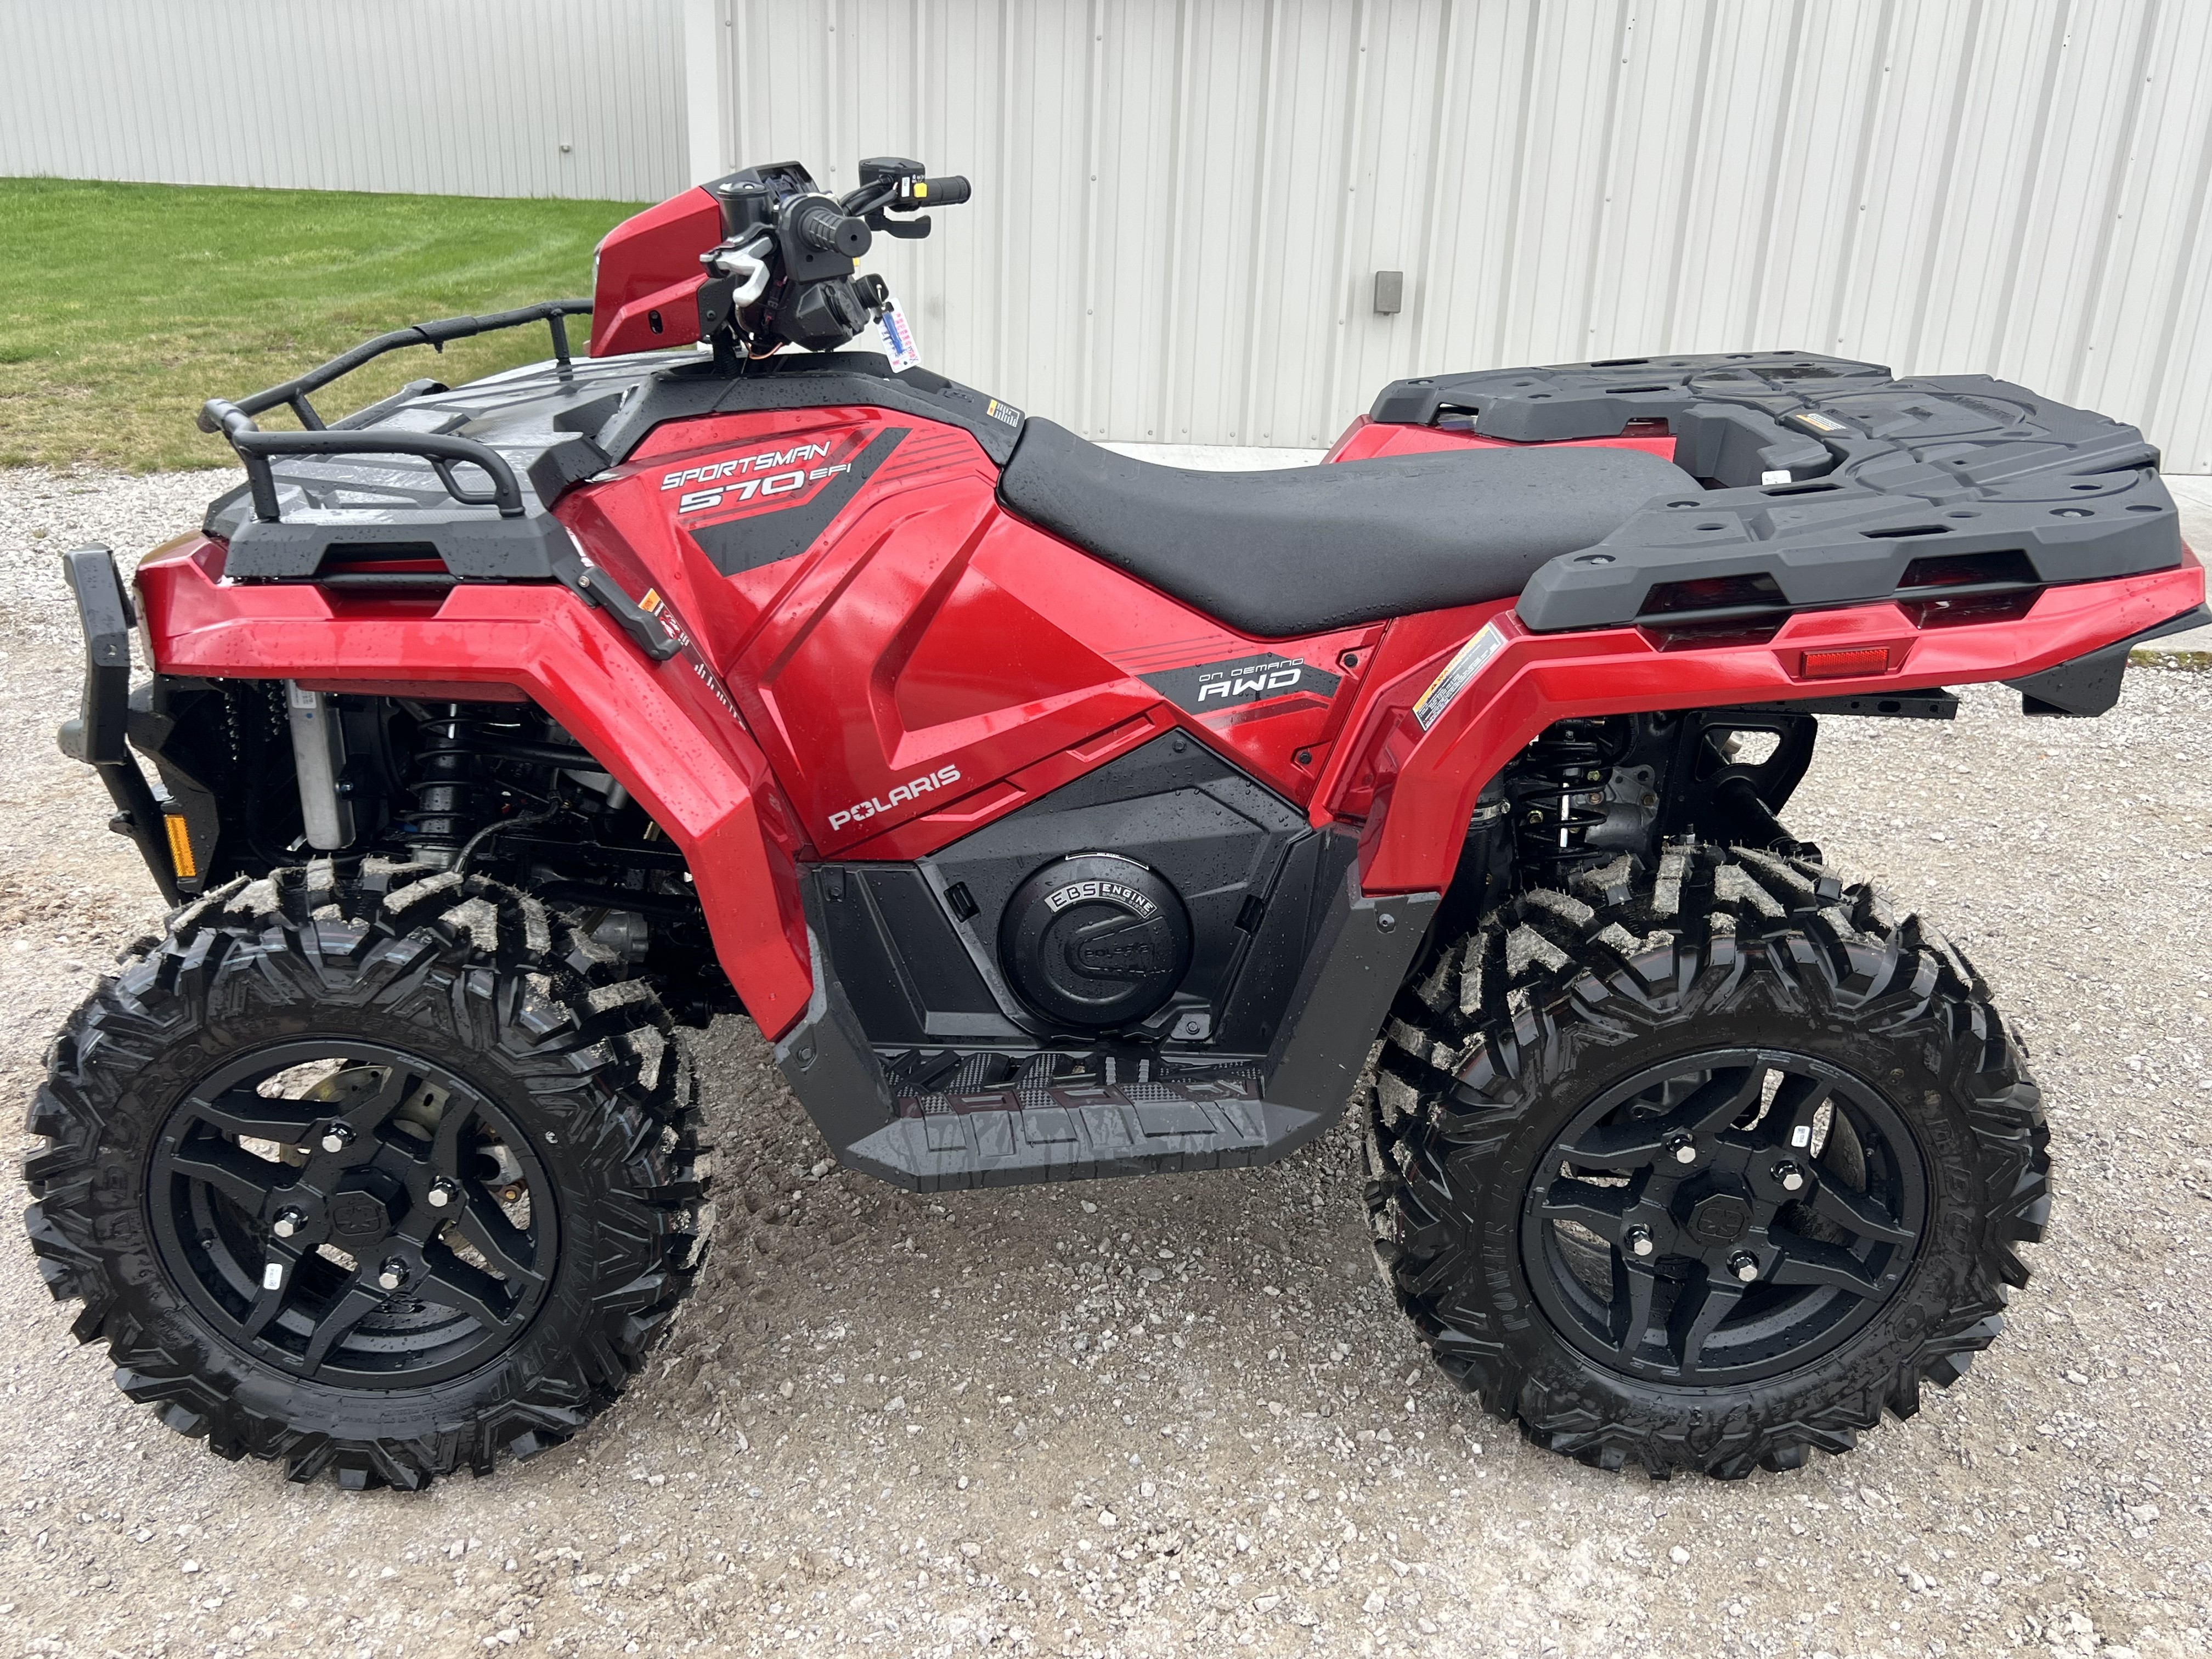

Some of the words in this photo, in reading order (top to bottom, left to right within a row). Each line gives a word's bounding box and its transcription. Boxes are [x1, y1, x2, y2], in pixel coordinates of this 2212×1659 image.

[660, 441, 831, 490] SPORTSMAN
[678, 470, 805, 514] 570
[809, 463, 851, 481] EFI
[1199, 672, 1223, 682] ON
[1231, 658, 1304, 677] DEMAND
[1437, 646, 1470, 681] WARNING
[1198, 668, 1301, 702] AWD
[828, 764, 961, 831] POLARIS
[1051, 883, 1097, 908] EBS
[1102, 883, 1154, 912] ENGINE
[1102, 892, 1126, 902] BRAKING
[1482, 1221, 1531, 1332] POWER
